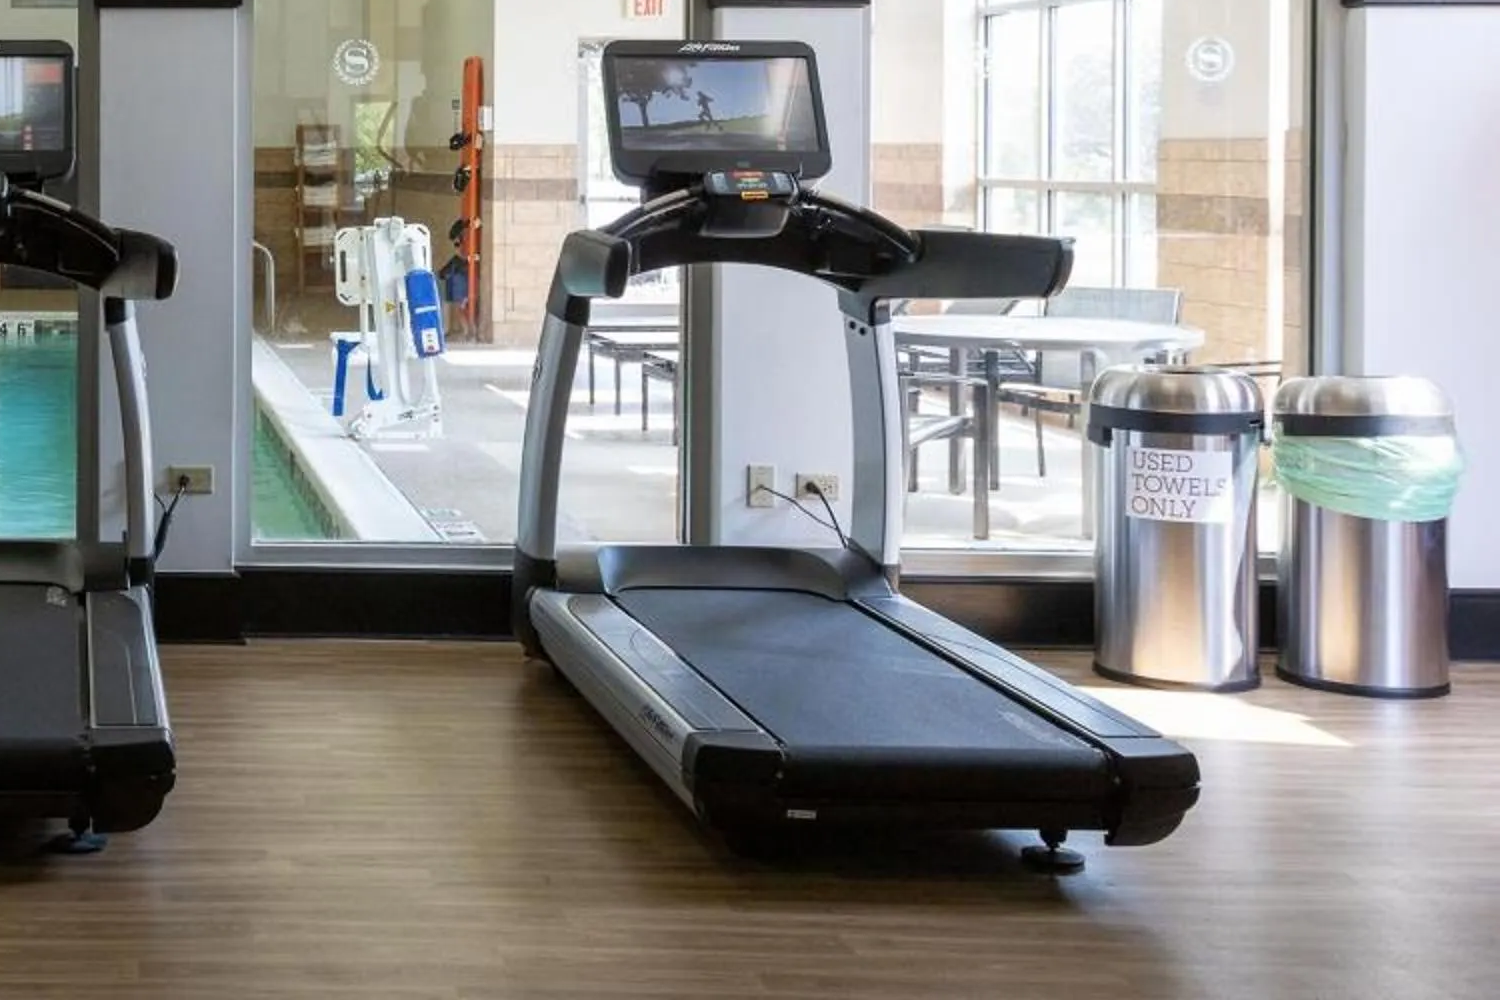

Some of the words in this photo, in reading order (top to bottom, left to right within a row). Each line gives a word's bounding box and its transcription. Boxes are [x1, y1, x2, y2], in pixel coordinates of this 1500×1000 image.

[1133, 451, 1193, 473] USED
[1132, 473, 1226, 497] TOWELS
[1131, 495, 1196, 519] ONLY
